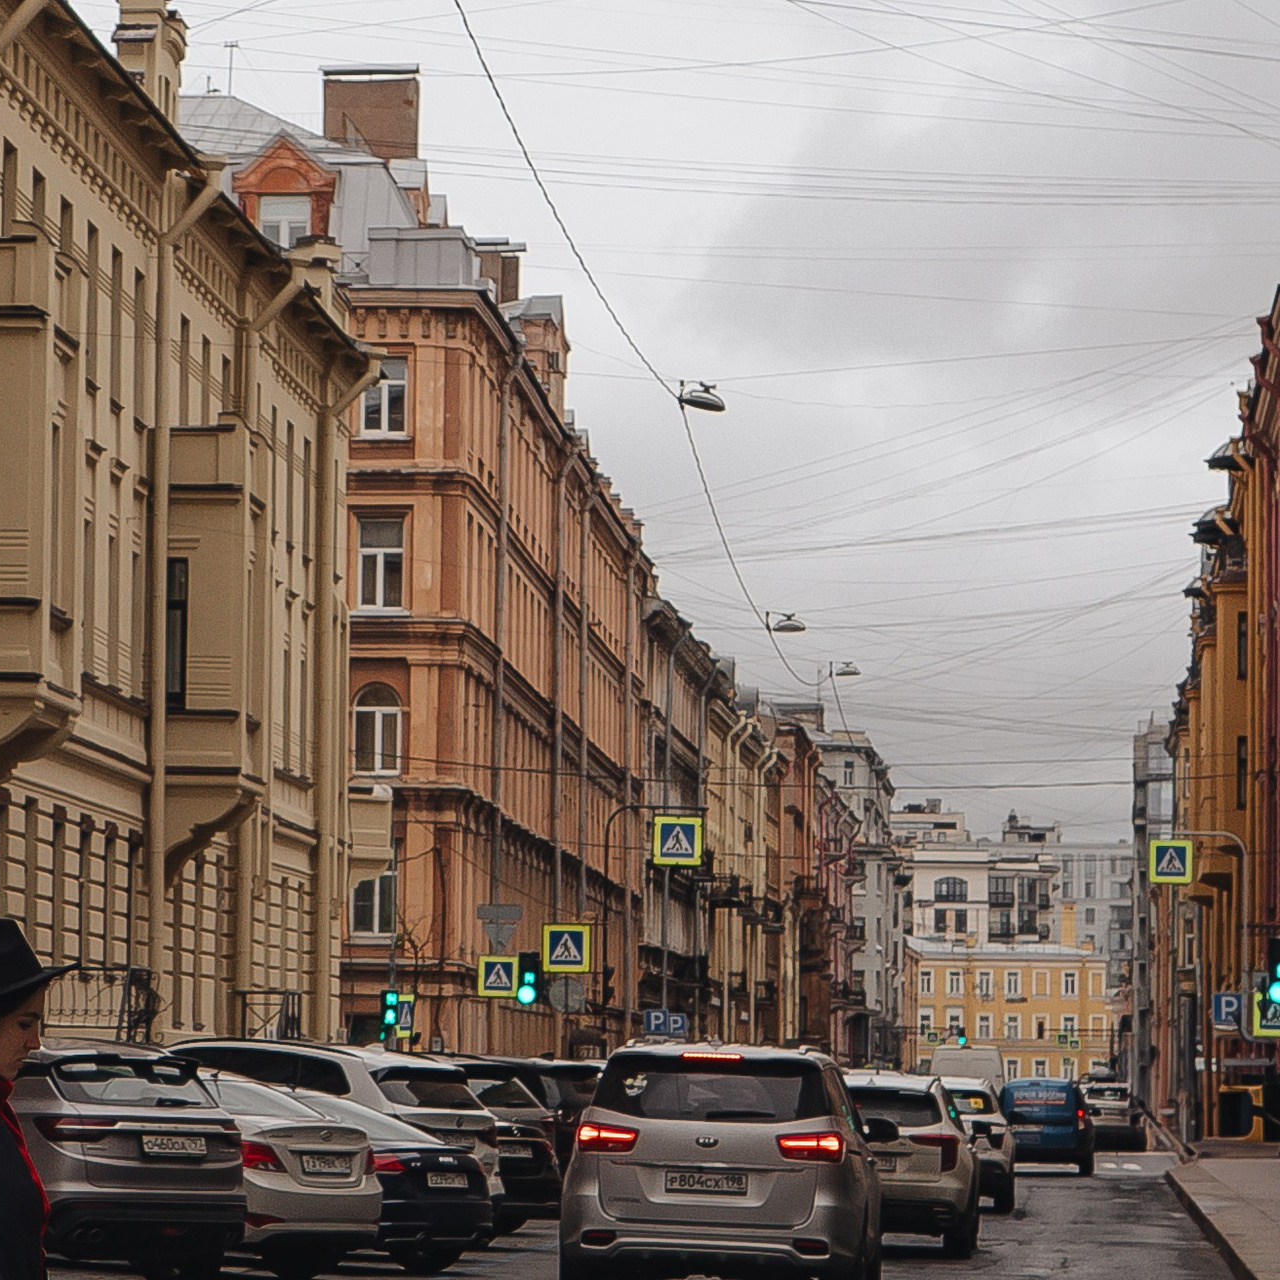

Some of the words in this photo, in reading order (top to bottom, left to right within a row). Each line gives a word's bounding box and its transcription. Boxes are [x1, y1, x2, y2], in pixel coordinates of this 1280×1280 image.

[1221, 996, 1238, 1020] P
[651, 1012, 664, 1031] P
[670, 1016, 682, 1033] P
